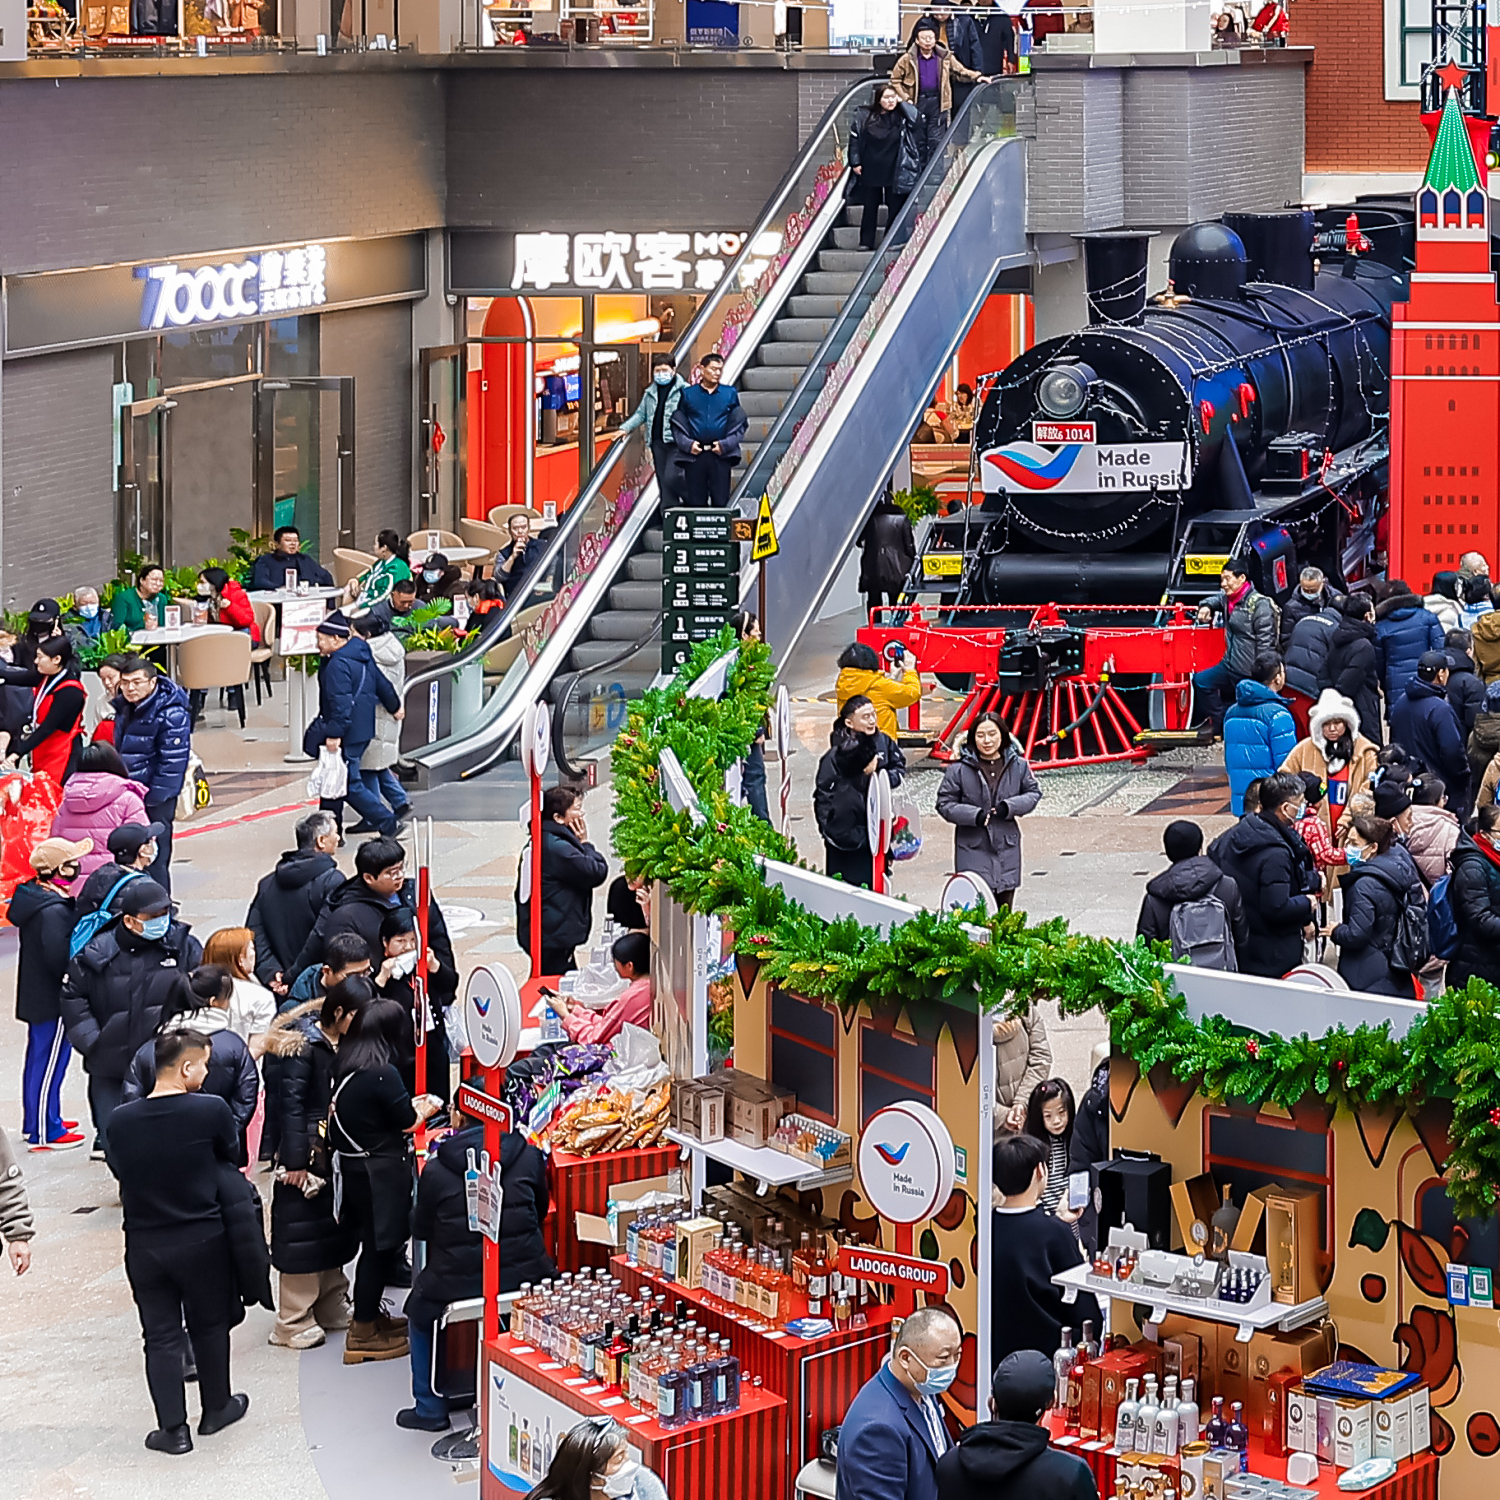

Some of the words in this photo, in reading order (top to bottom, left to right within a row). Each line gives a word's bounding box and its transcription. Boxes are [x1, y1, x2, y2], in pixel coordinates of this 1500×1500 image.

[510, 231, 691, 290] 摩欧客
[1065, 427, 1090, 440] 1014
[1098, 450, 1150, 466] Made
[1098, 472, 1115, 488] in
[1123, 470, 1188, 487] Russia
[676, 516, 688, 530] 4
[676, 549, 687, 565] 3
[675, 583, 686, 598] 2
[677, 617, 684, 632] 1
[464, 1094, 487, 1114] LADOGA
[486, 1105, 505, 1123] GROUP
[893, 1173, 912, 1184] Made
[893, 1184, 901, 1192] in
[902, 1184, 925, 1197] Russia
[850, 1256, 897, 1276] LADOGA
[899, 1265, 937, 1284] GROUP
